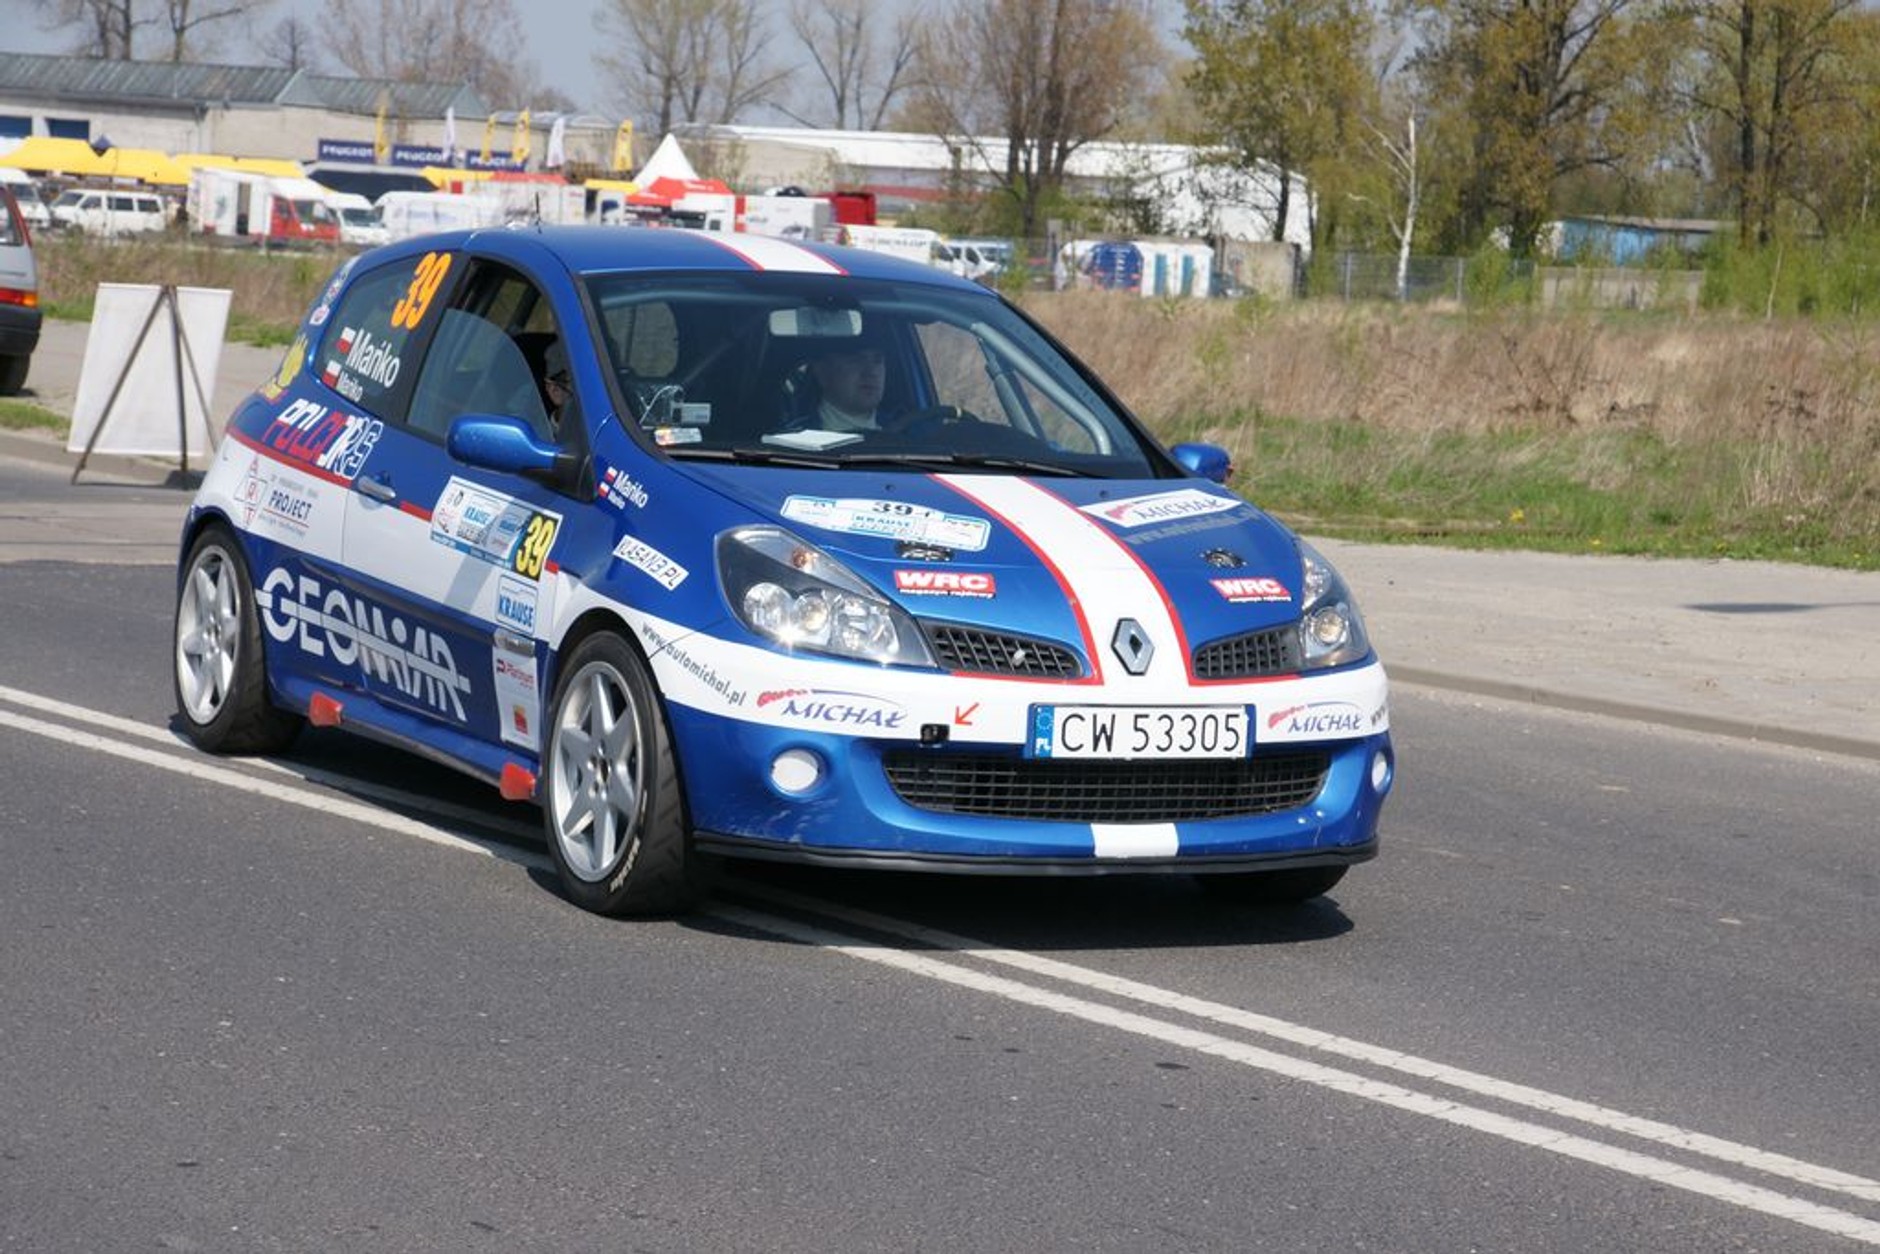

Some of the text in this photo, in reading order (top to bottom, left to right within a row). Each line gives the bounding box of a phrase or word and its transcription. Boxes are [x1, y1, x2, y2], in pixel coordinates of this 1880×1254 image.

[323, 145, 372, 157] PEUGEOT
[391, 252, 452, 329] 39
[345, 328, 401, 389] Mańko
[268, 489, 312, 521] PROJECT
[873, 501, 914, 516] 39
[515, 515, 555, 578] 39
[898, 571, 989, 590] WRC
[1212, 579, 1281, 595] WRC
[499, 594, 534, 628] KRAUSE
[642, 622, 747, 706] www.automichal.pl
[781, 700, 907, 728] MICHAŁ
[1036, 737, 1052, 755] PL
[1061, 713, 1116, 752] CW
[1132, 713, 1241, 752] 53305
